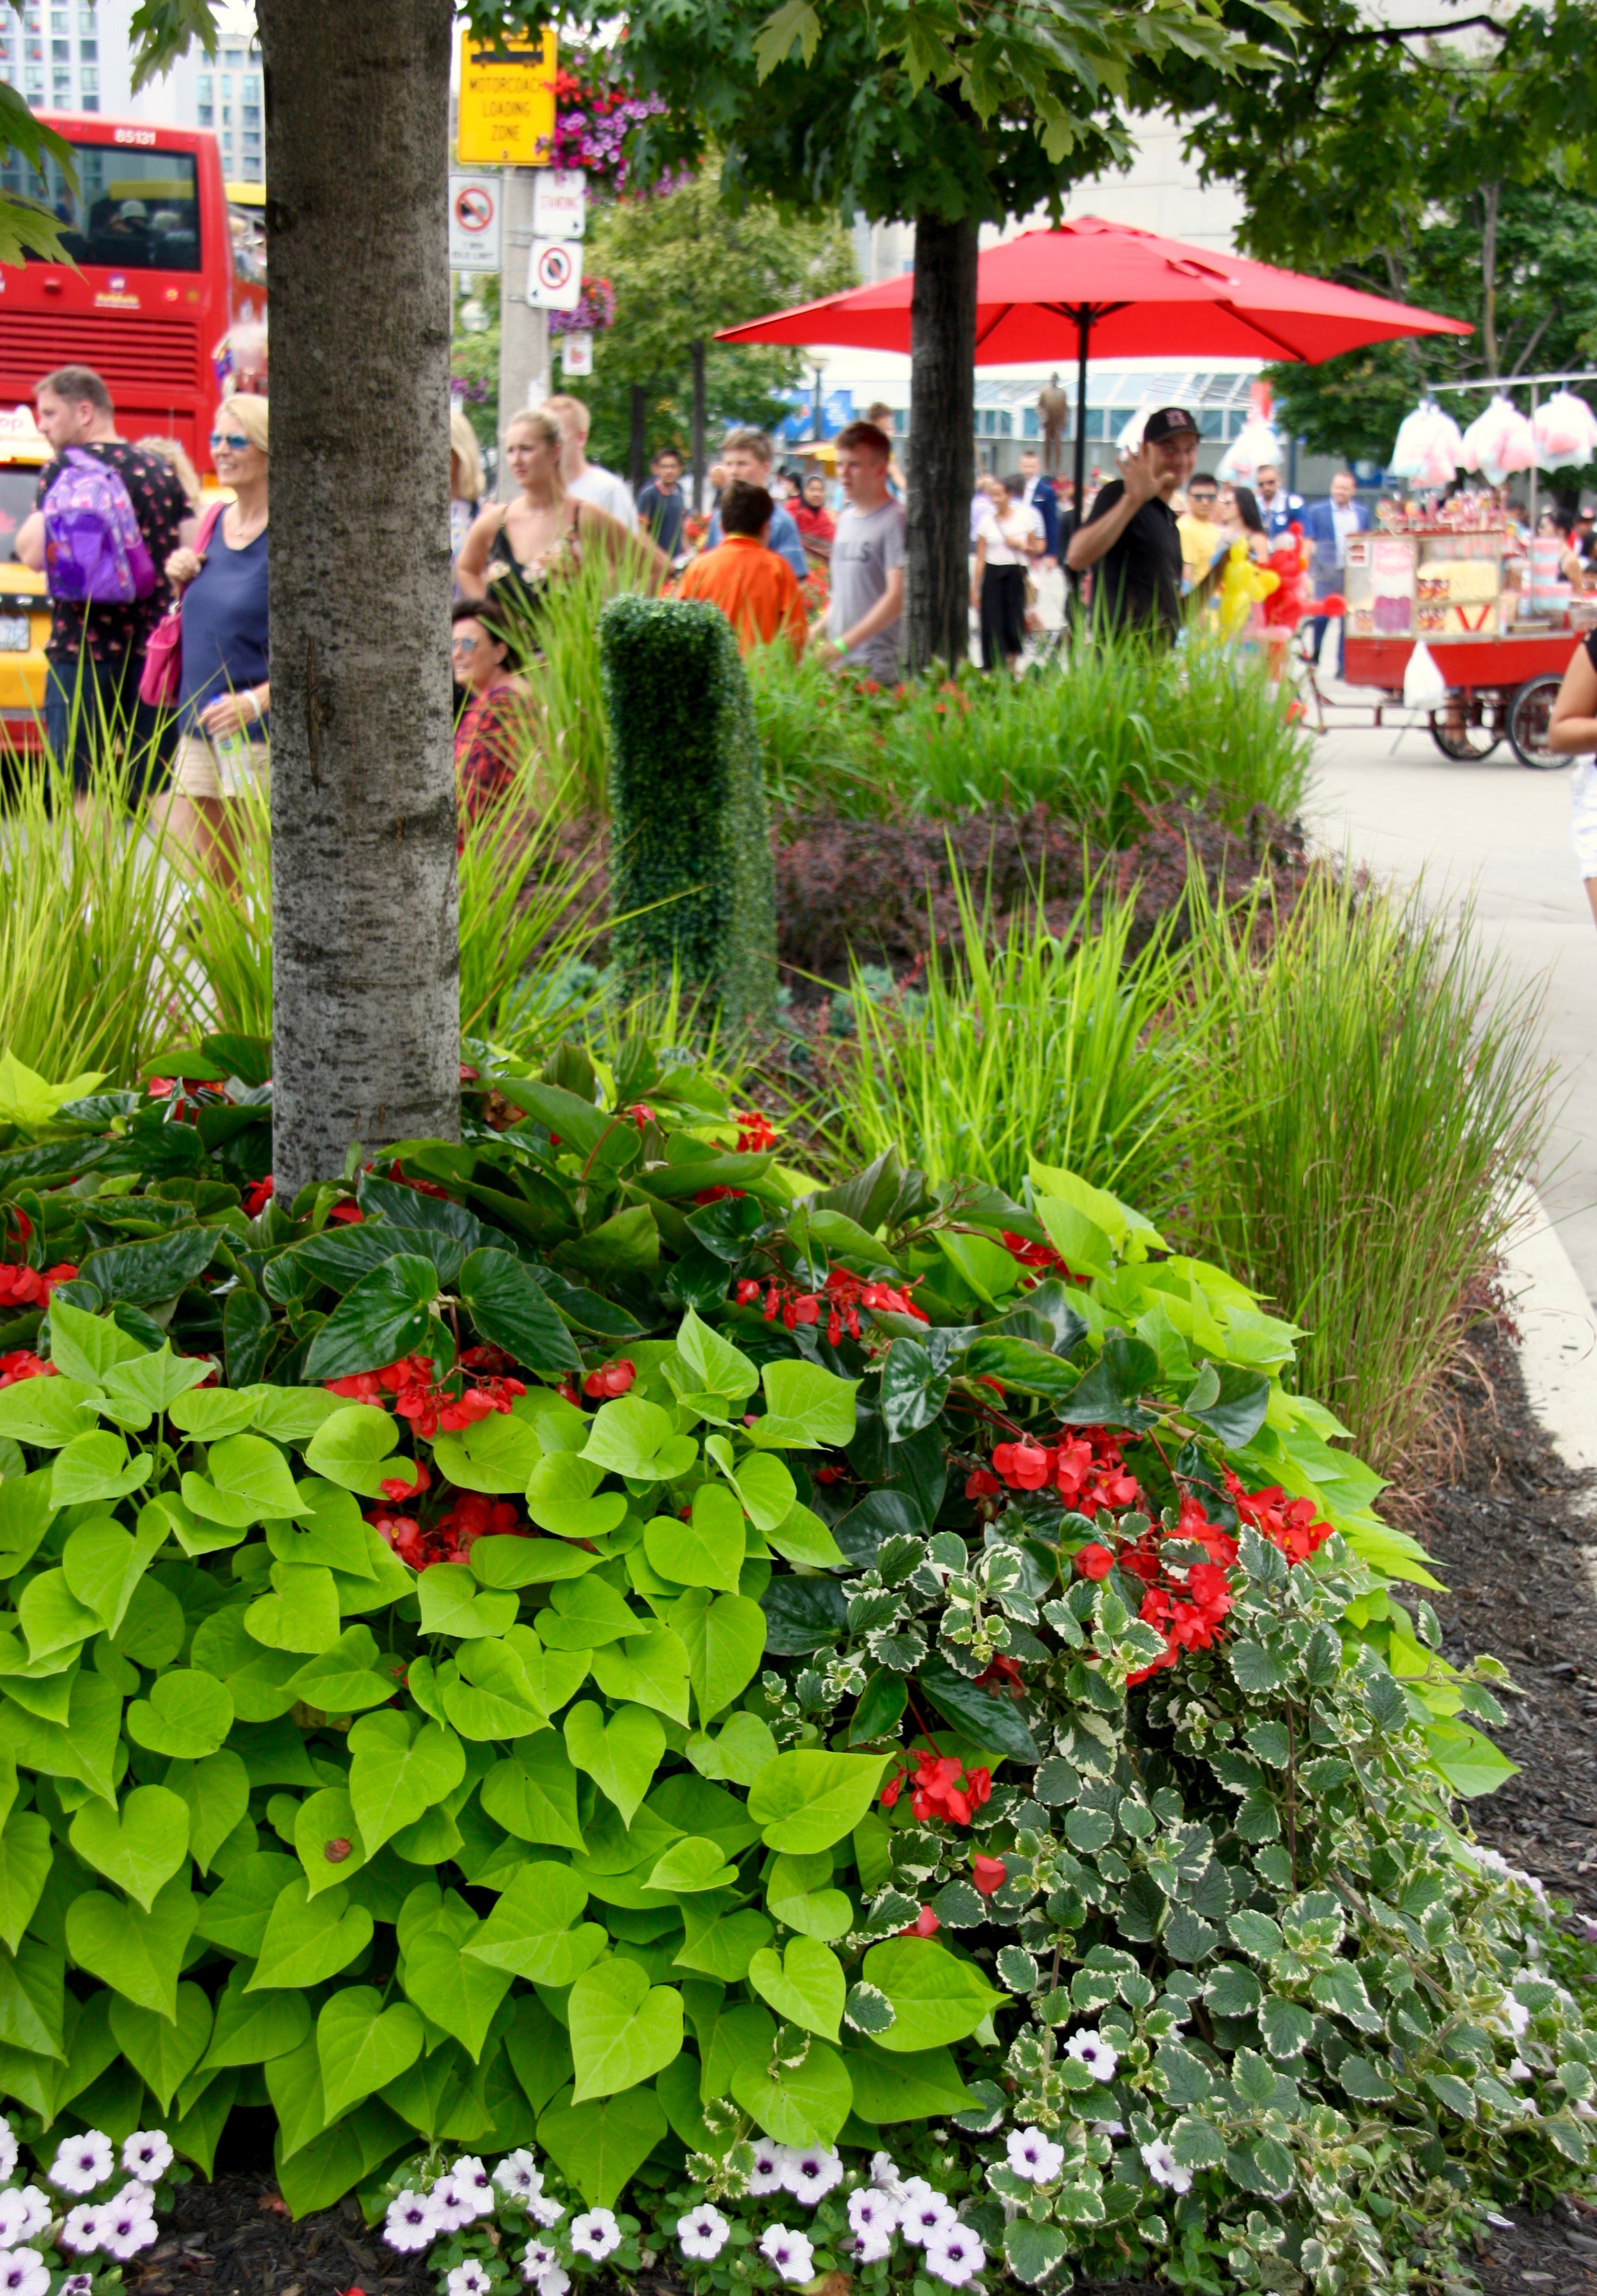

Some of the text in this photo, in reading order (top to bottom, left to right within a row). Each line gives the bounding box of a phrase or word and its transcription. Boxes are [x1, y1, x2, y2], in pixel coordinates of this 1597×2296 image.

[483, 101, 530, 118] LOADING
[114, 128, 156, 145] 85131
[492, 125, 520, 141] ZONE
